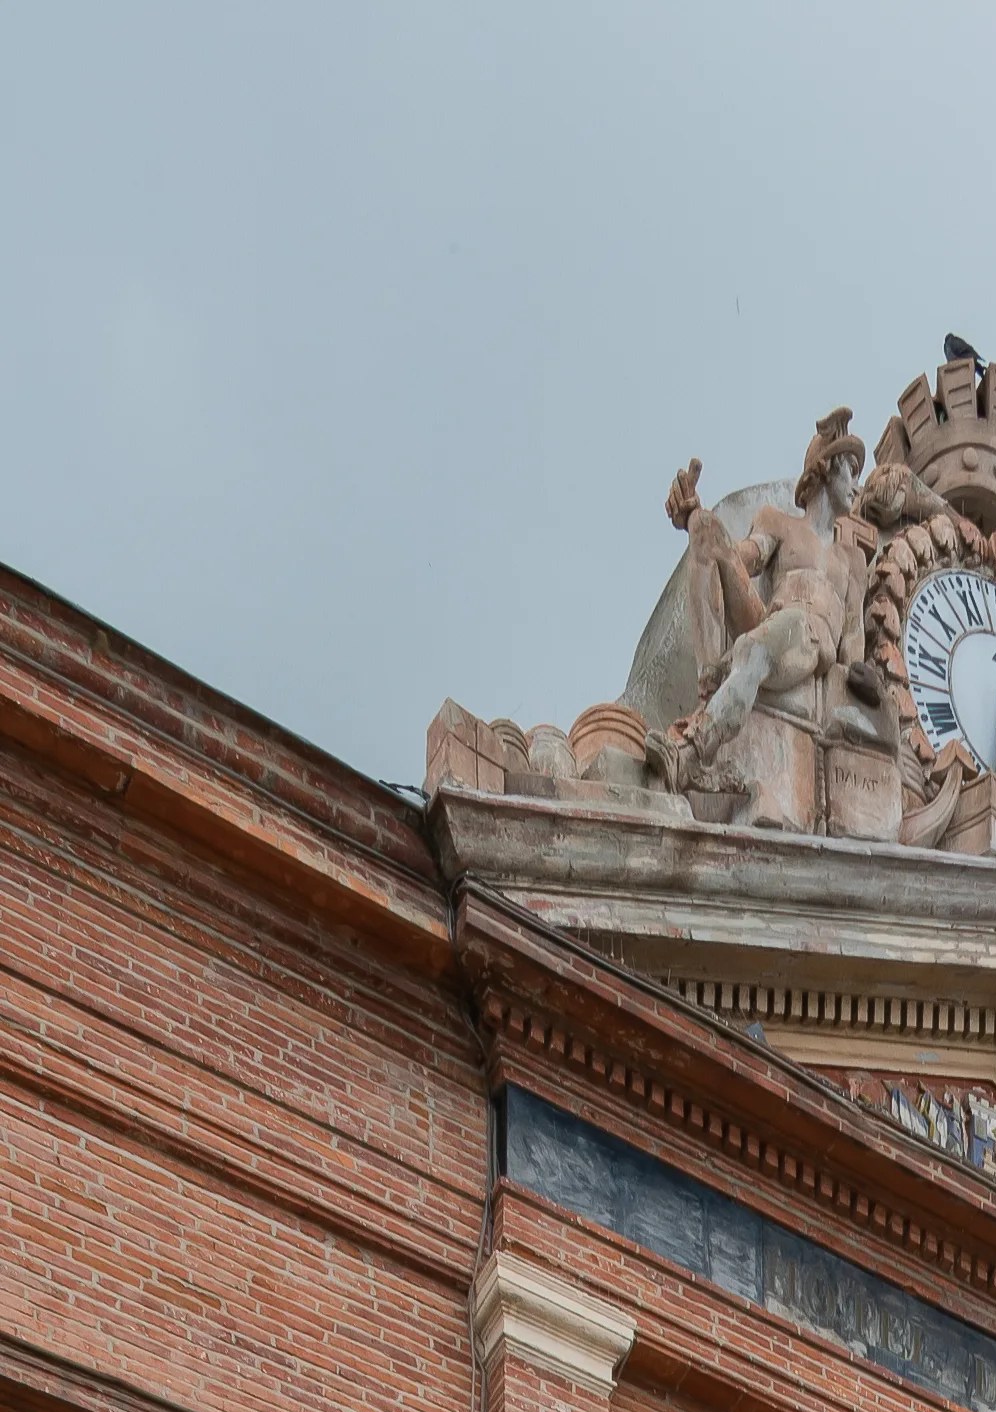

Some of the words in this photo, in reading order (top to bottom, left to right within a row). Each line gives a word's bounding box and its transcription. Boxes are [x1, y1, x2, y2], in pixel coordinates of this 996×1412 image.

[928, 604, 956, 641] X
[957, 590, 983, 626] XI
[918, 647, 947, 681] IX
